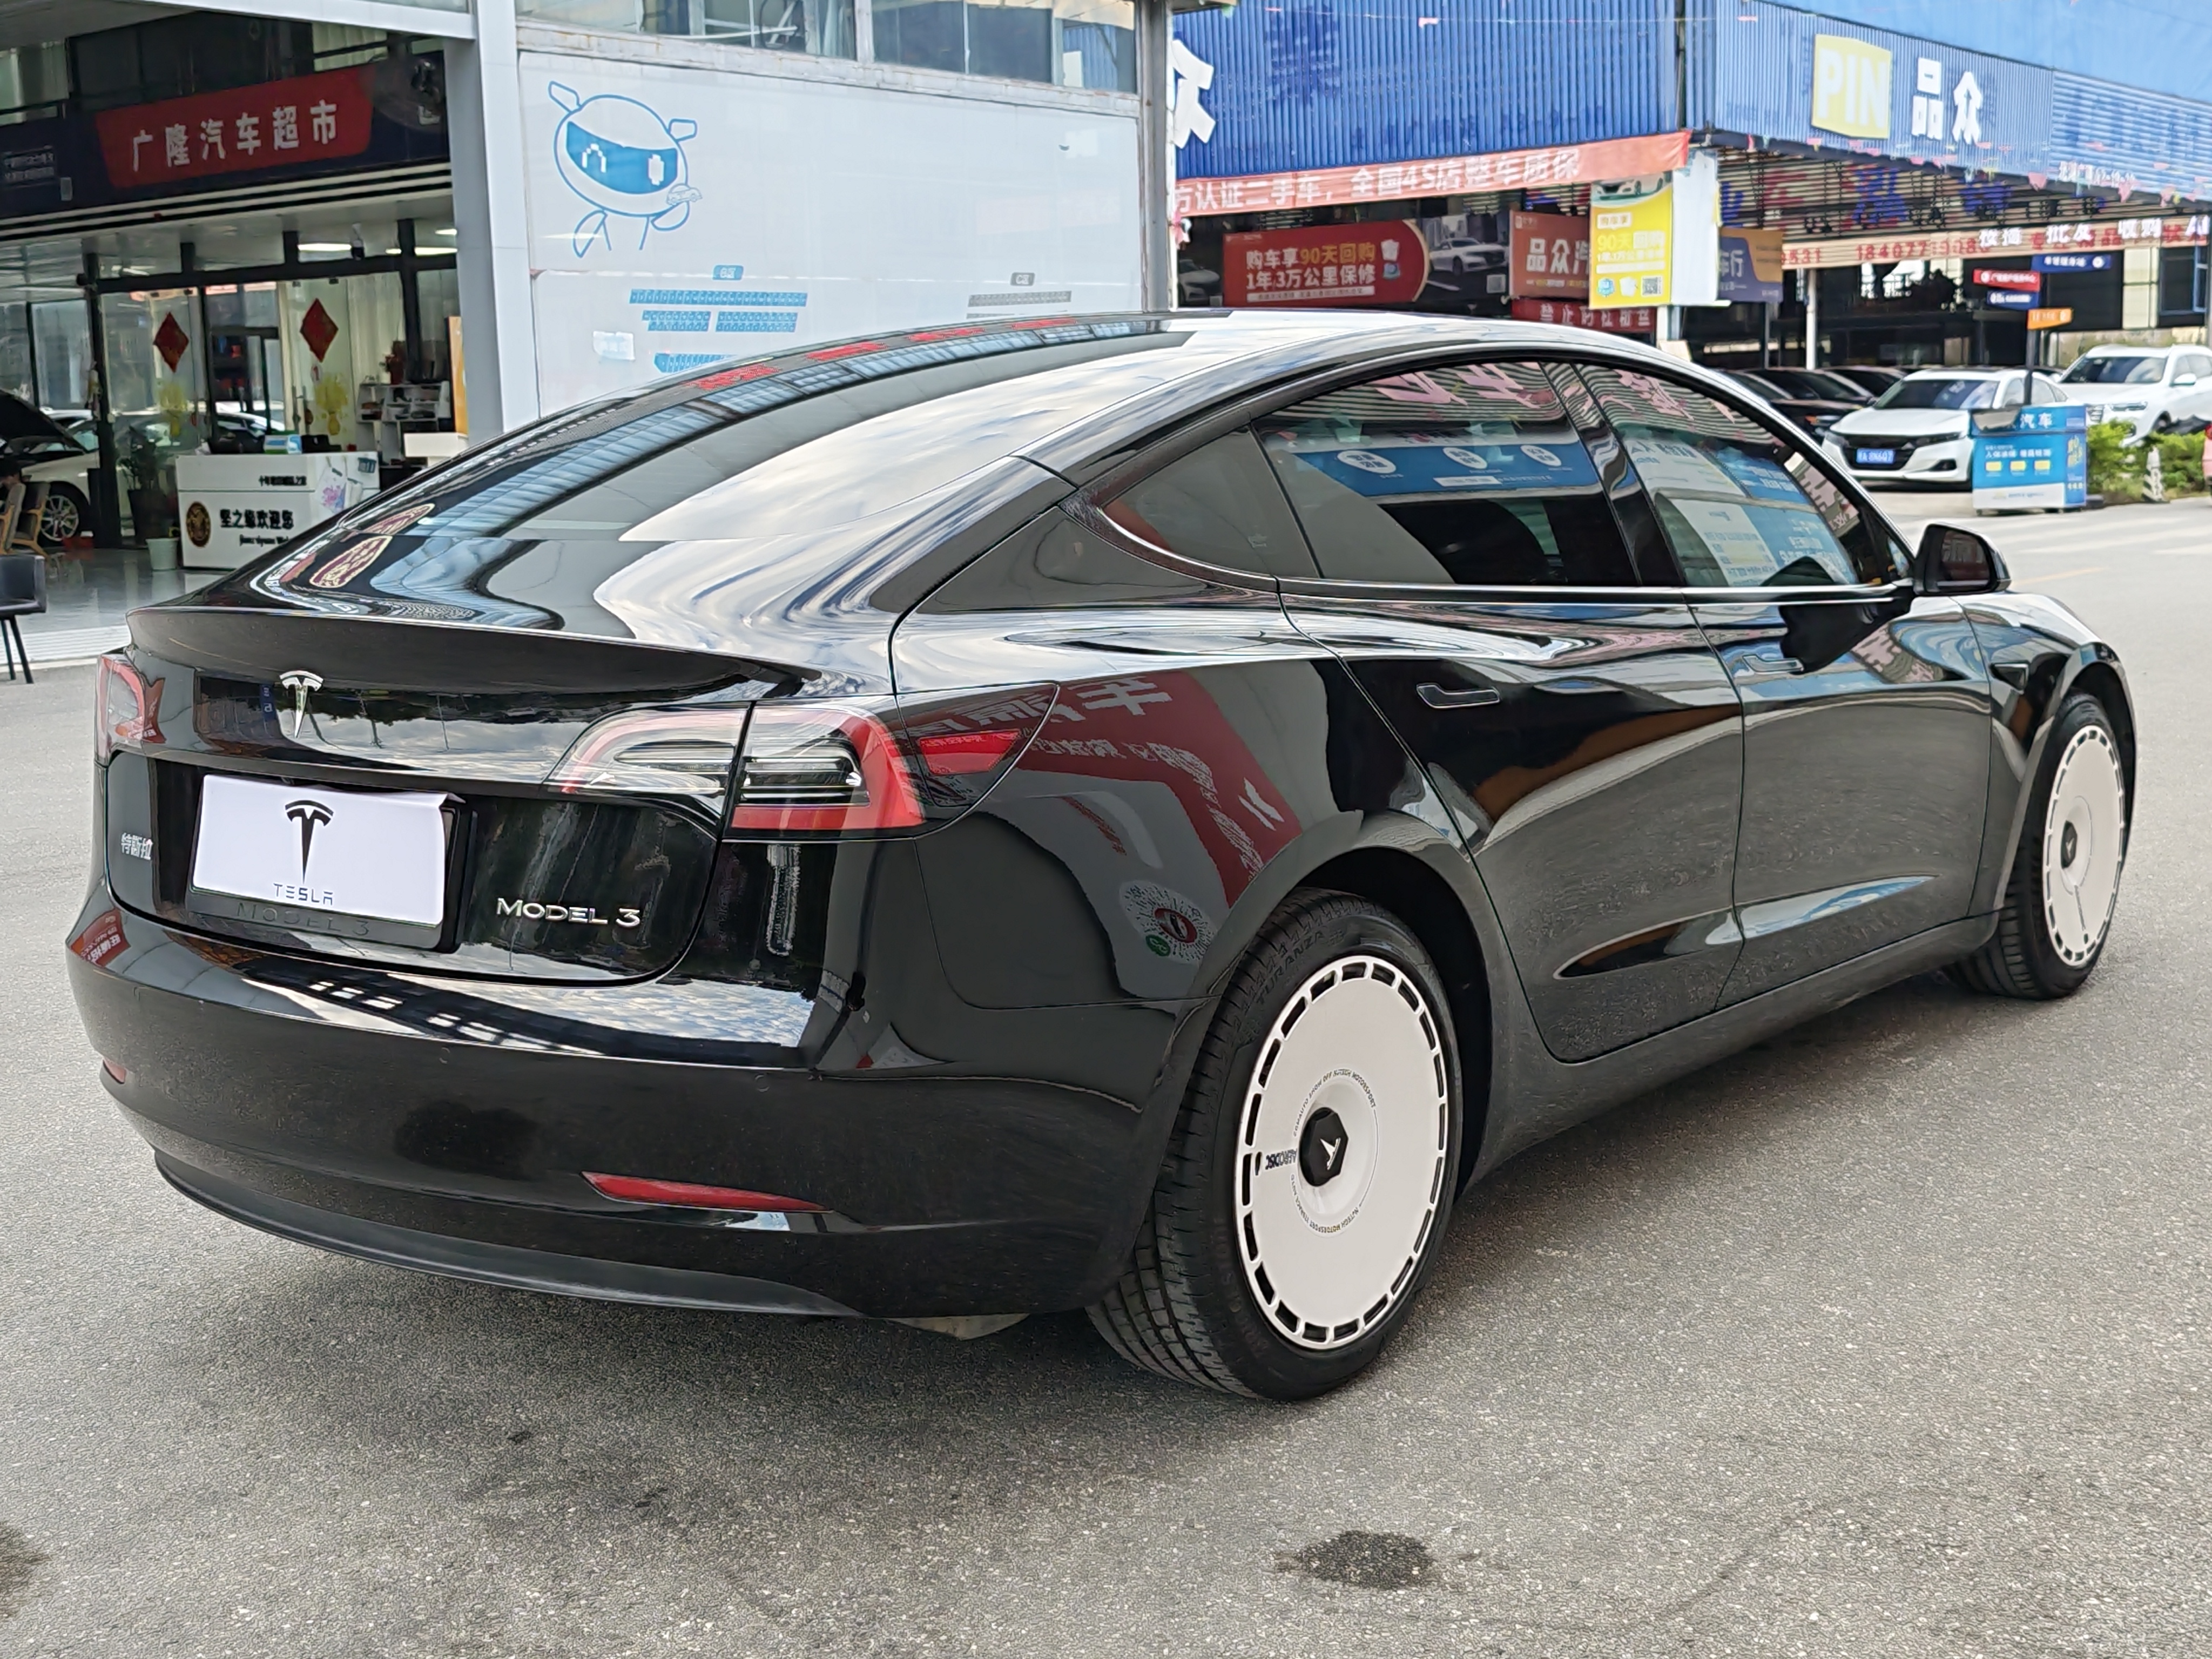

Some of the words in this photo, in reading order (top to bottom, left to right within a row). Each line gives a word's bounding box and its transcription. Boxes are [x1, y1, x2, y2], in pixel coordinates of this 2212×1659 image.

[1817, 49, 1889, 129] PIN
[1911, 57, 1983, 145] 品众
[132, 99, 339, 172] 广隆汽车超市
[1246, 242, 1375, 271] 购车享90天回购
[121, 832, 153, 860] 特斯拉
[273, 882, 333, 906] TESLA
[496, 897, 609, 925] MODEL
[616, 907, 640, 927] 3
[352, 919, 370, 936] 3
[1256, 930, 1325, 1006] TURANZA
